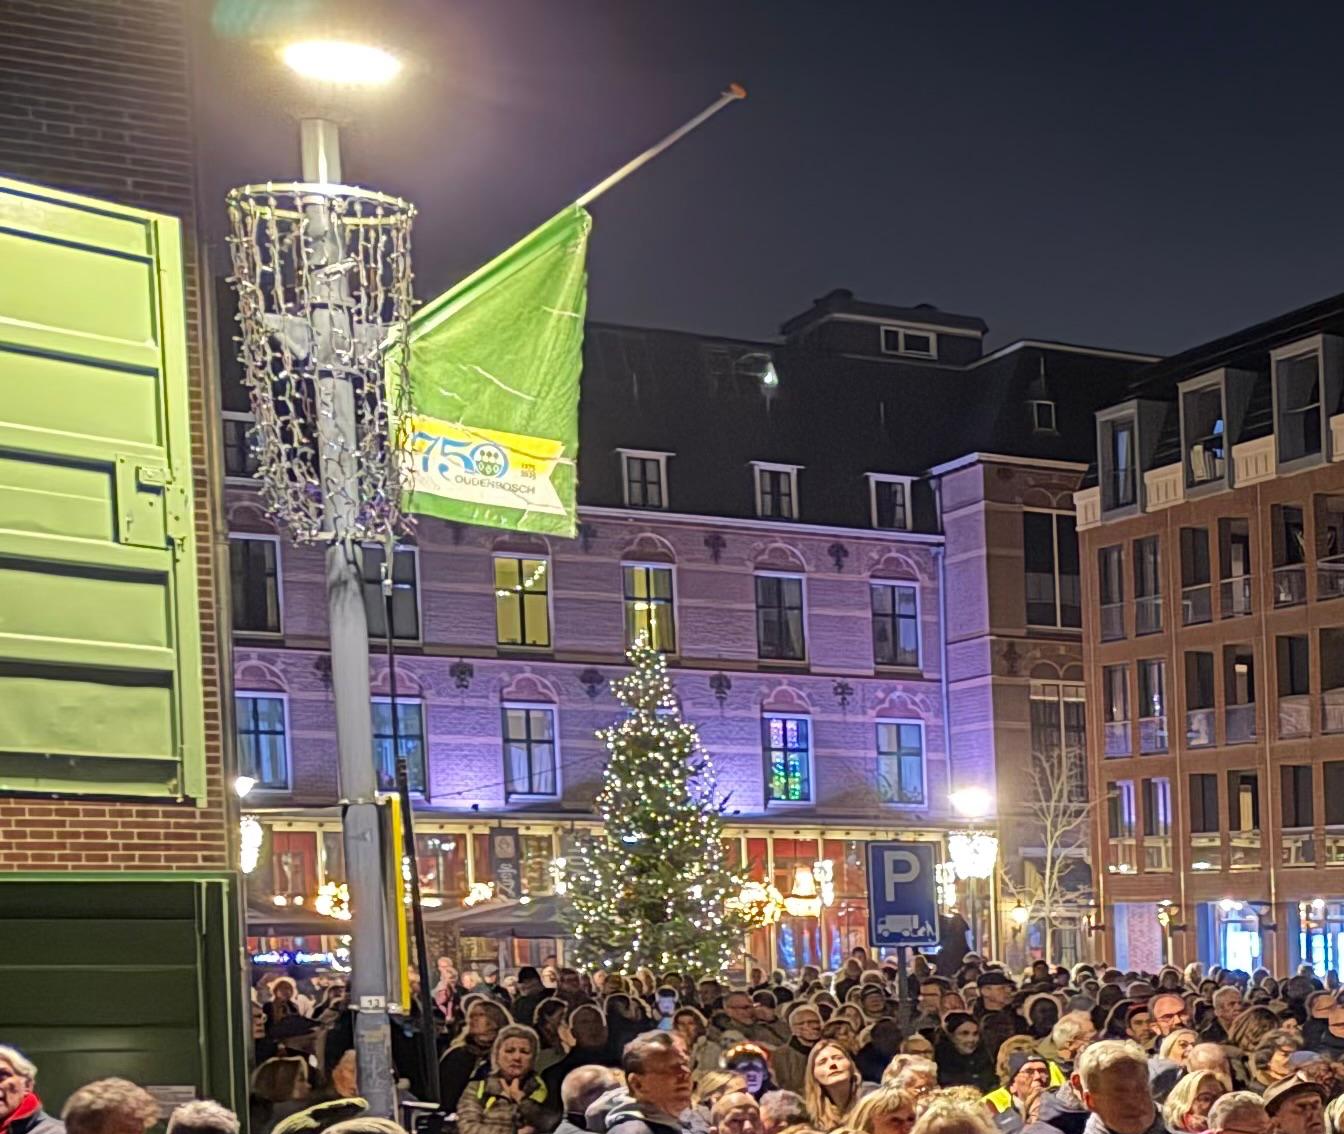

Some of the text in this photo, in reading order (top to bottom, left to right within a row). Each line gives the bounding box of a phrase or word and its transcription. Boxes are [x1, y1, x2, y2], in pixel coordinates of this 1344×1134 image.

[413, 432, 508, 481] 750
[455, 474, 536, 494] OUDENBOSCH
[884, 850, 920, 902] P
